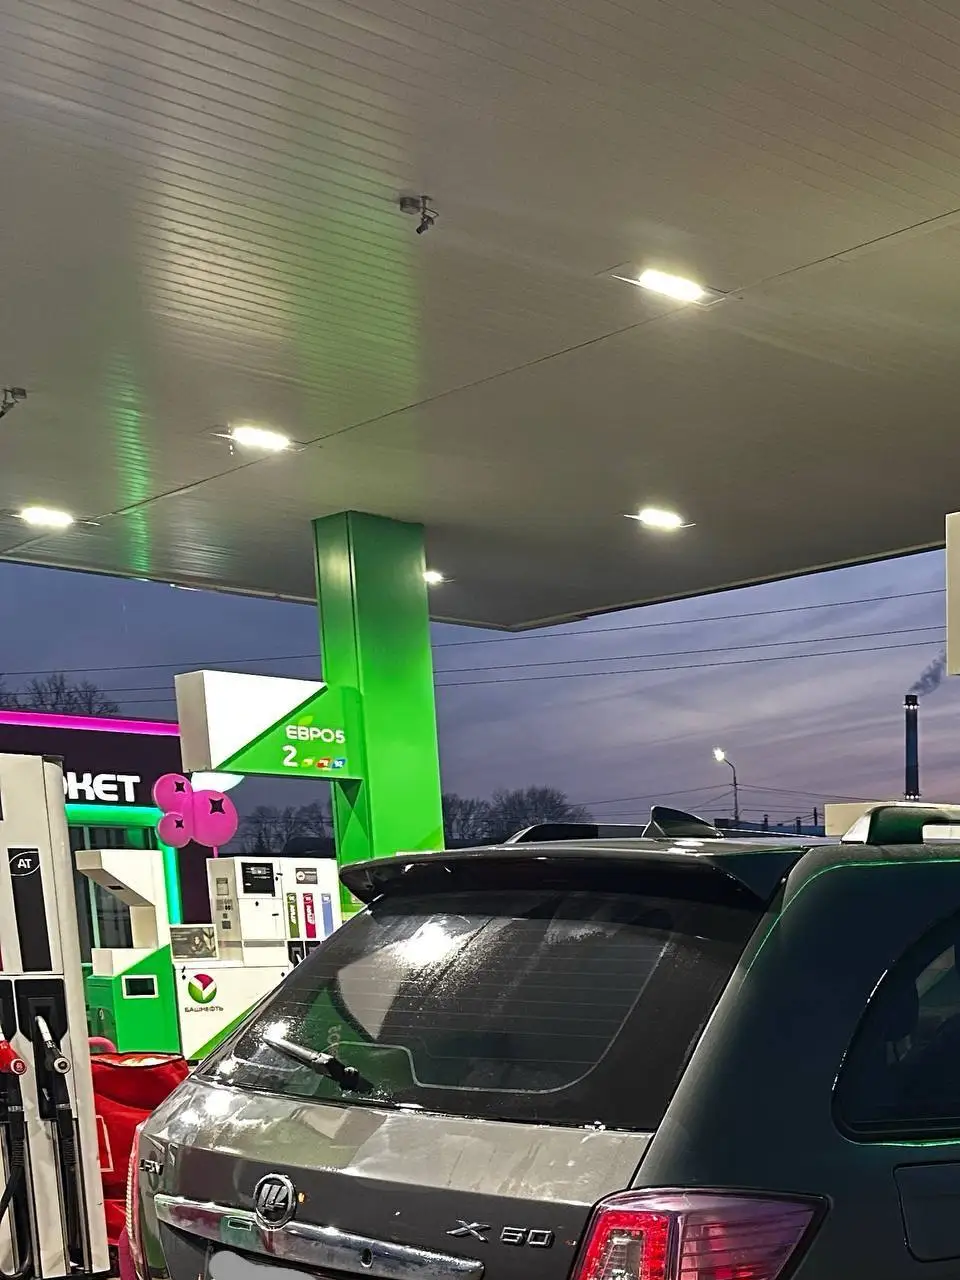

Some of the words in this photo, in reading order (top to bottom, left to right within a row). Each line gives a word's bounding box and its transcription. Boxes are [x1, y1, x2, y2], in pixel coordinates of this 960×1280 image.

[282, 745, 298, 767] 2
[446, 1219, 491, 1243] X
[500, 1226, 554, 1247] 60
